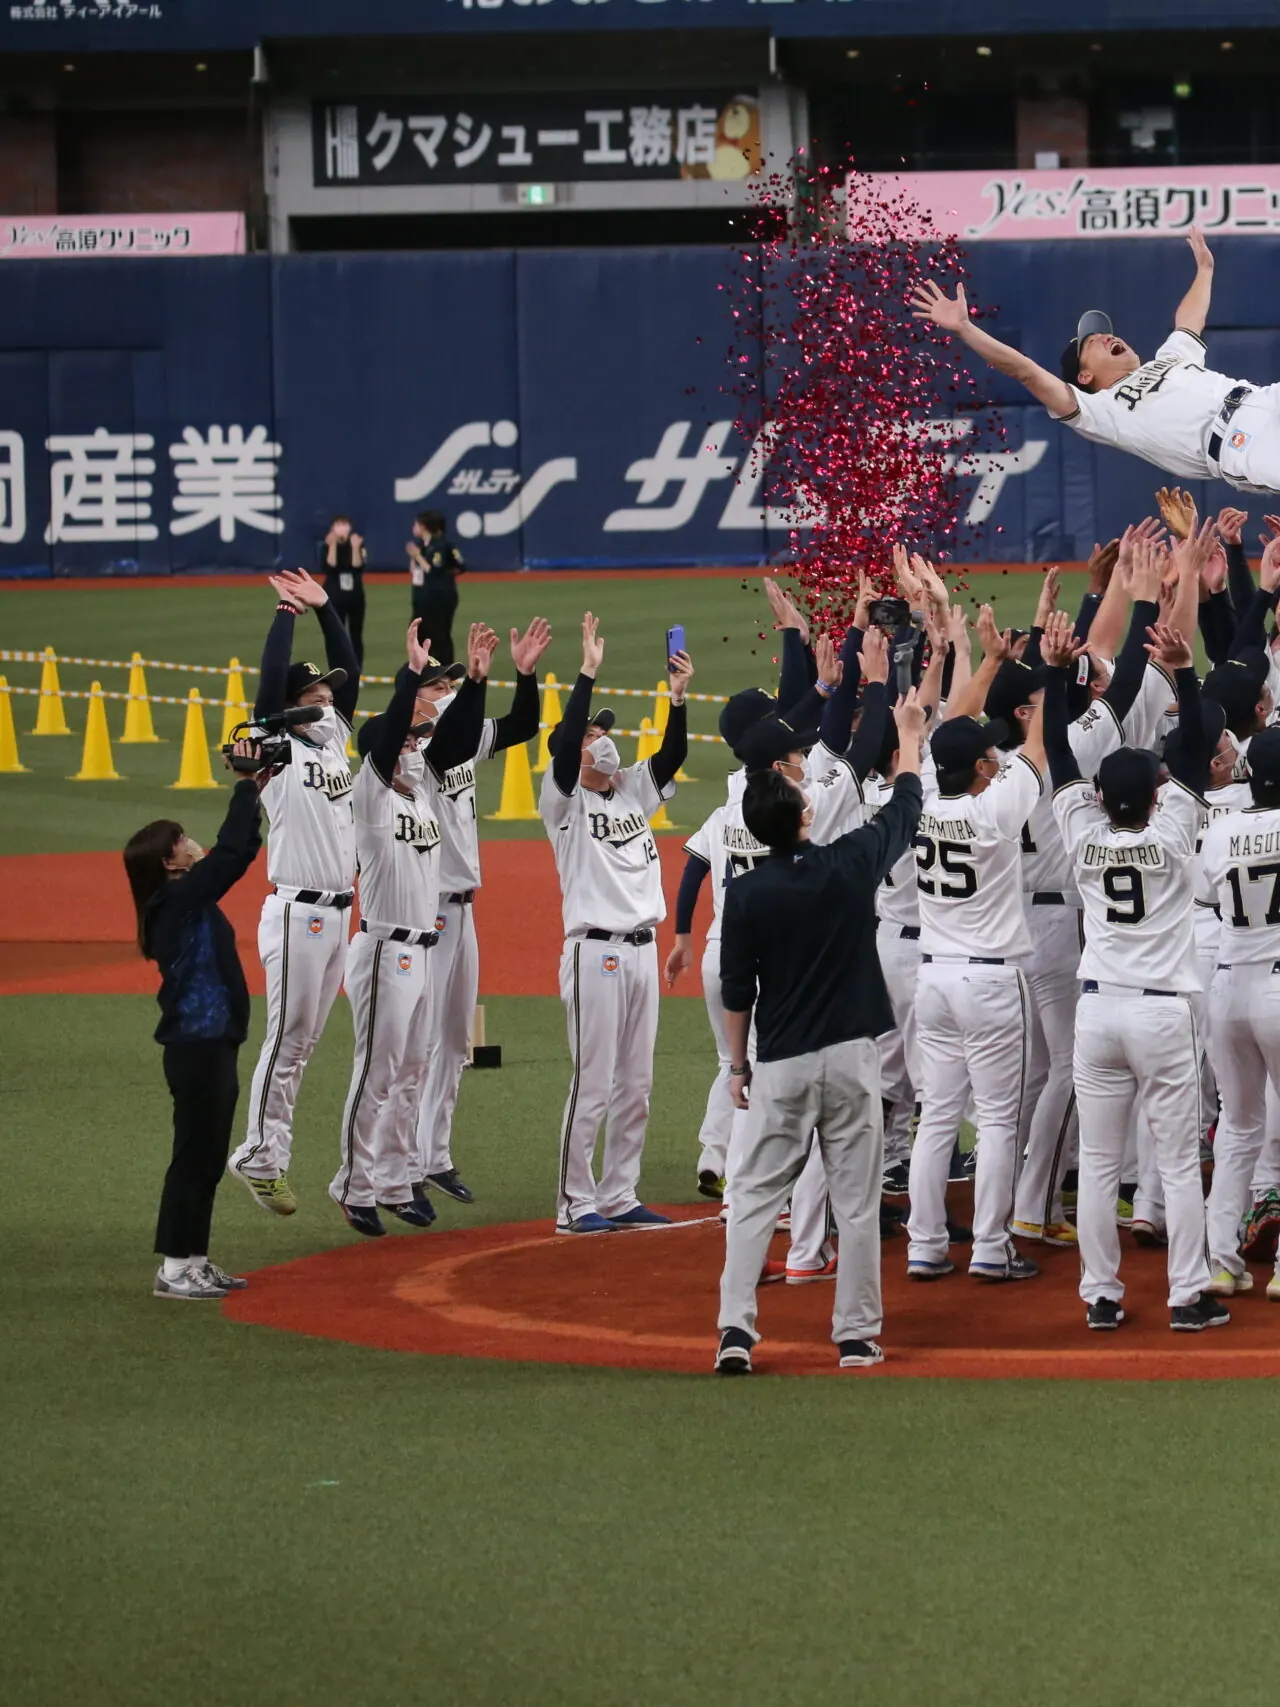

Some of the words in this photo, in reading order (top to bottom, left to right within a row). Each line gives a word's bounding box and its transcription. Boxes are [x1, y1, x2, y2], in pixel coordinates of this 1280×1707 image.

[366, 104, 718, 172] クマシュー工務店
[56, 227, 191, 252] 高須クリニック
[0, 423, 285, 546] 産業
[910, 835, 978, 899] 25
[1084, 844, 1161, 867] OHSHIRO
[1103, 865, 1146, 924] 9
